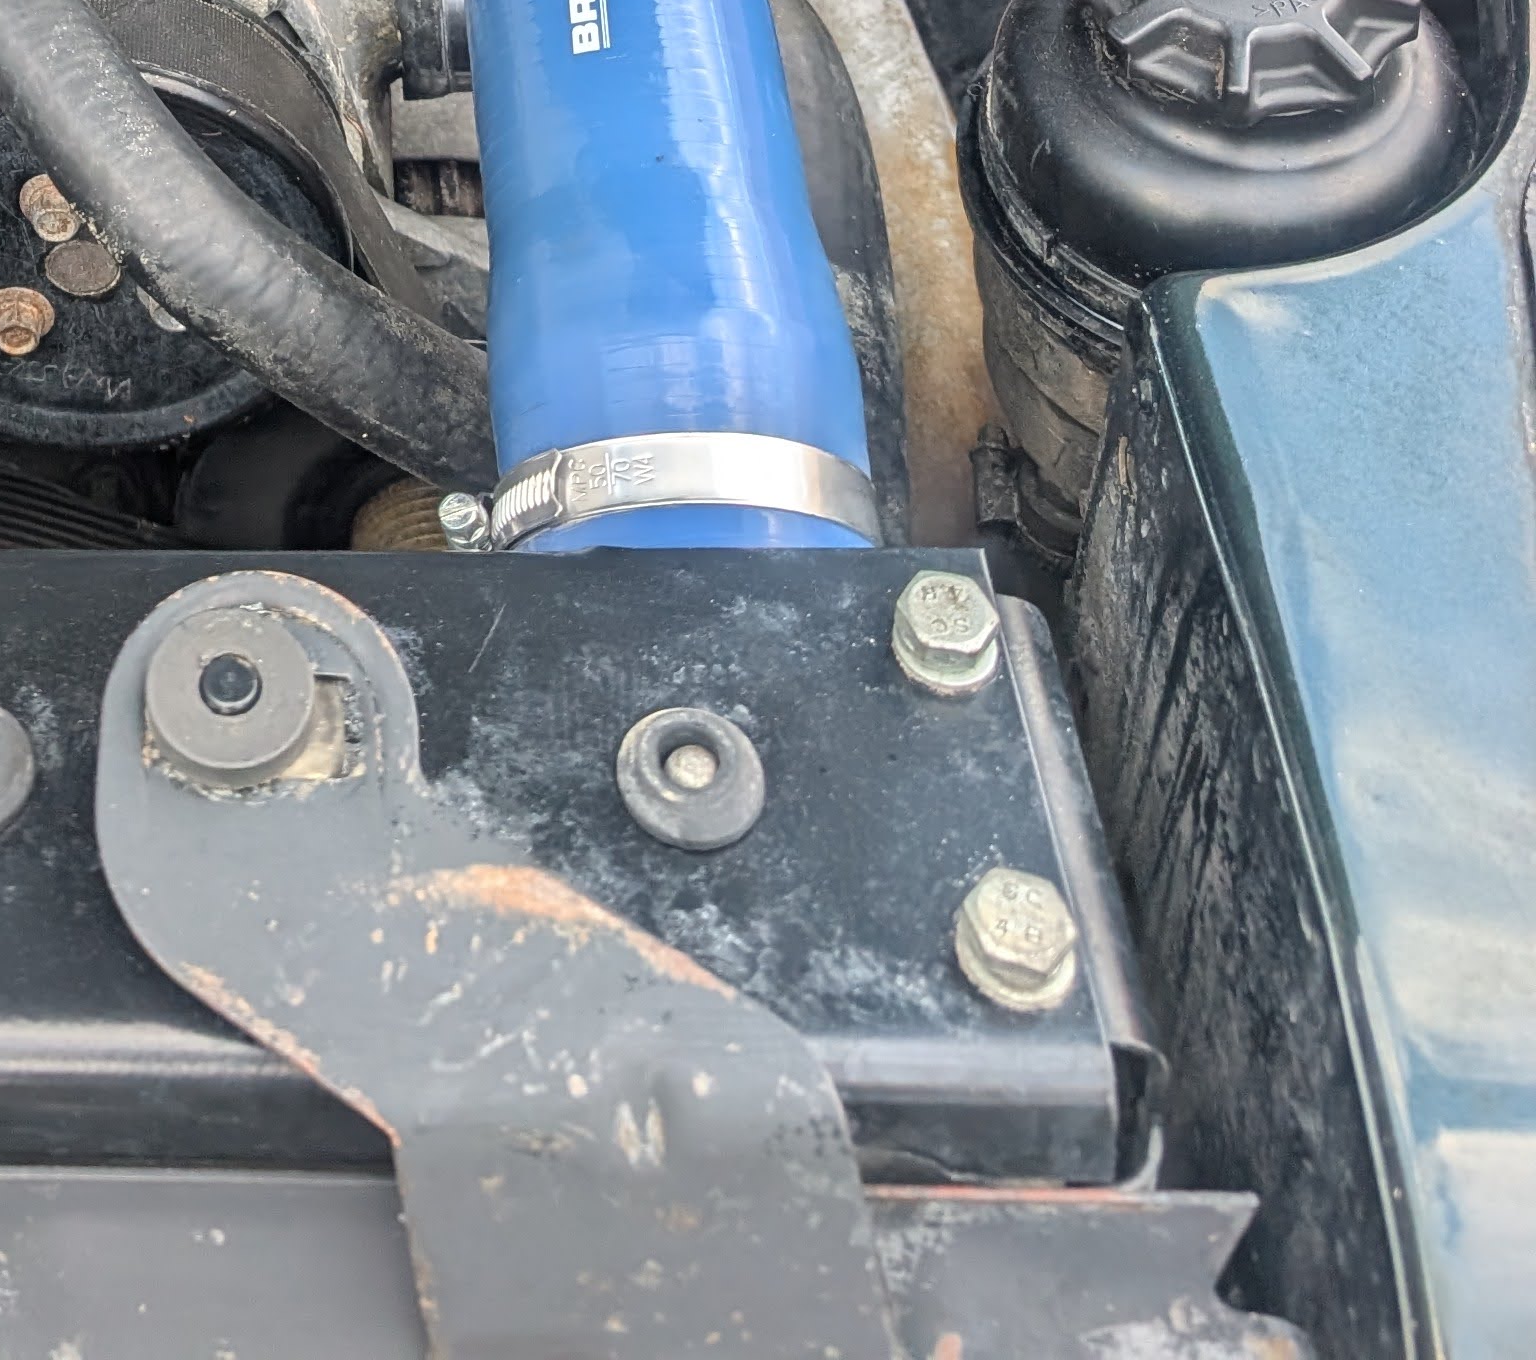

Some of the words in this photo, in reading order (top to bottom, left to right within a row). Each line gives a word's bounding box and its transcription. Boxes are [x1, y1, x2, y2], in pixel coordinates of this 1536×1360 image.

[587, 463, 607, 490] 50
[610, 457, 632, 486] 70
[632, 452, 656, 486] W4
